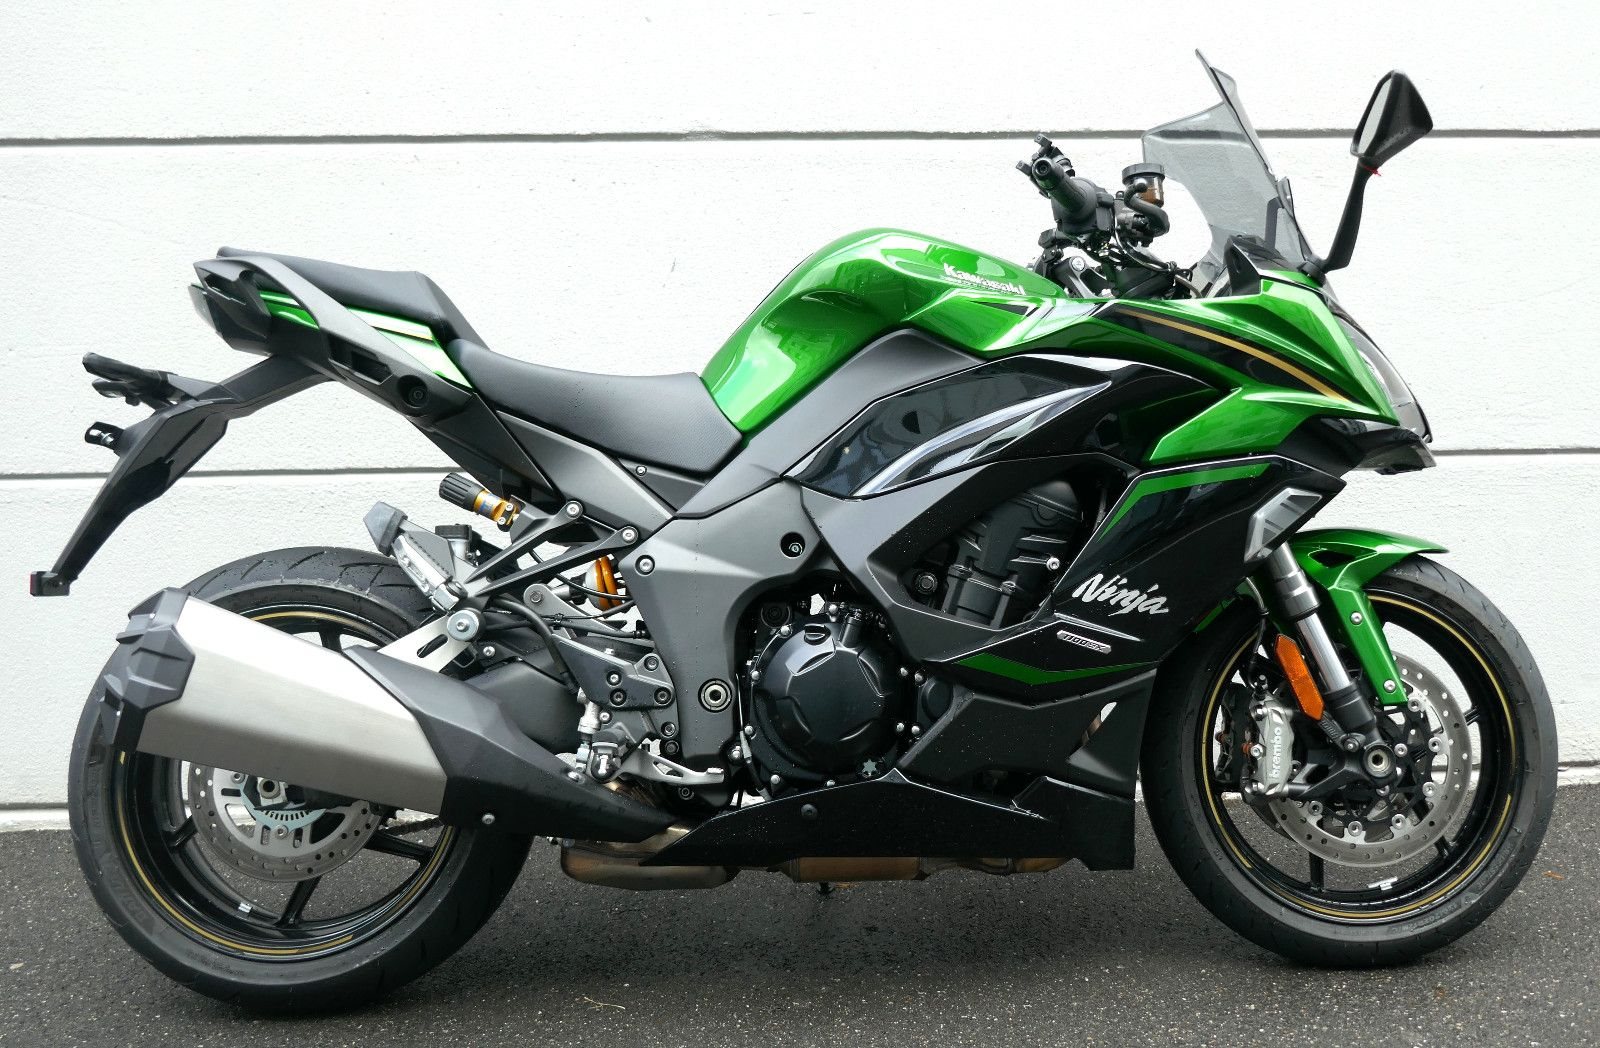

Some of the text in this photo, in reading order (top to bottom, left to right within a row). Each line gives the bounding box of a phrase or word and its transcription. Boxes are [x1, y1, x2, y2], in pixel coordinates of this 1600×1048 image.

[943, 262, 1026, 296] Kawasaki
[1071, 573, 1169, 617] Ninja
[1268, 726, 1282, 779] brembo
